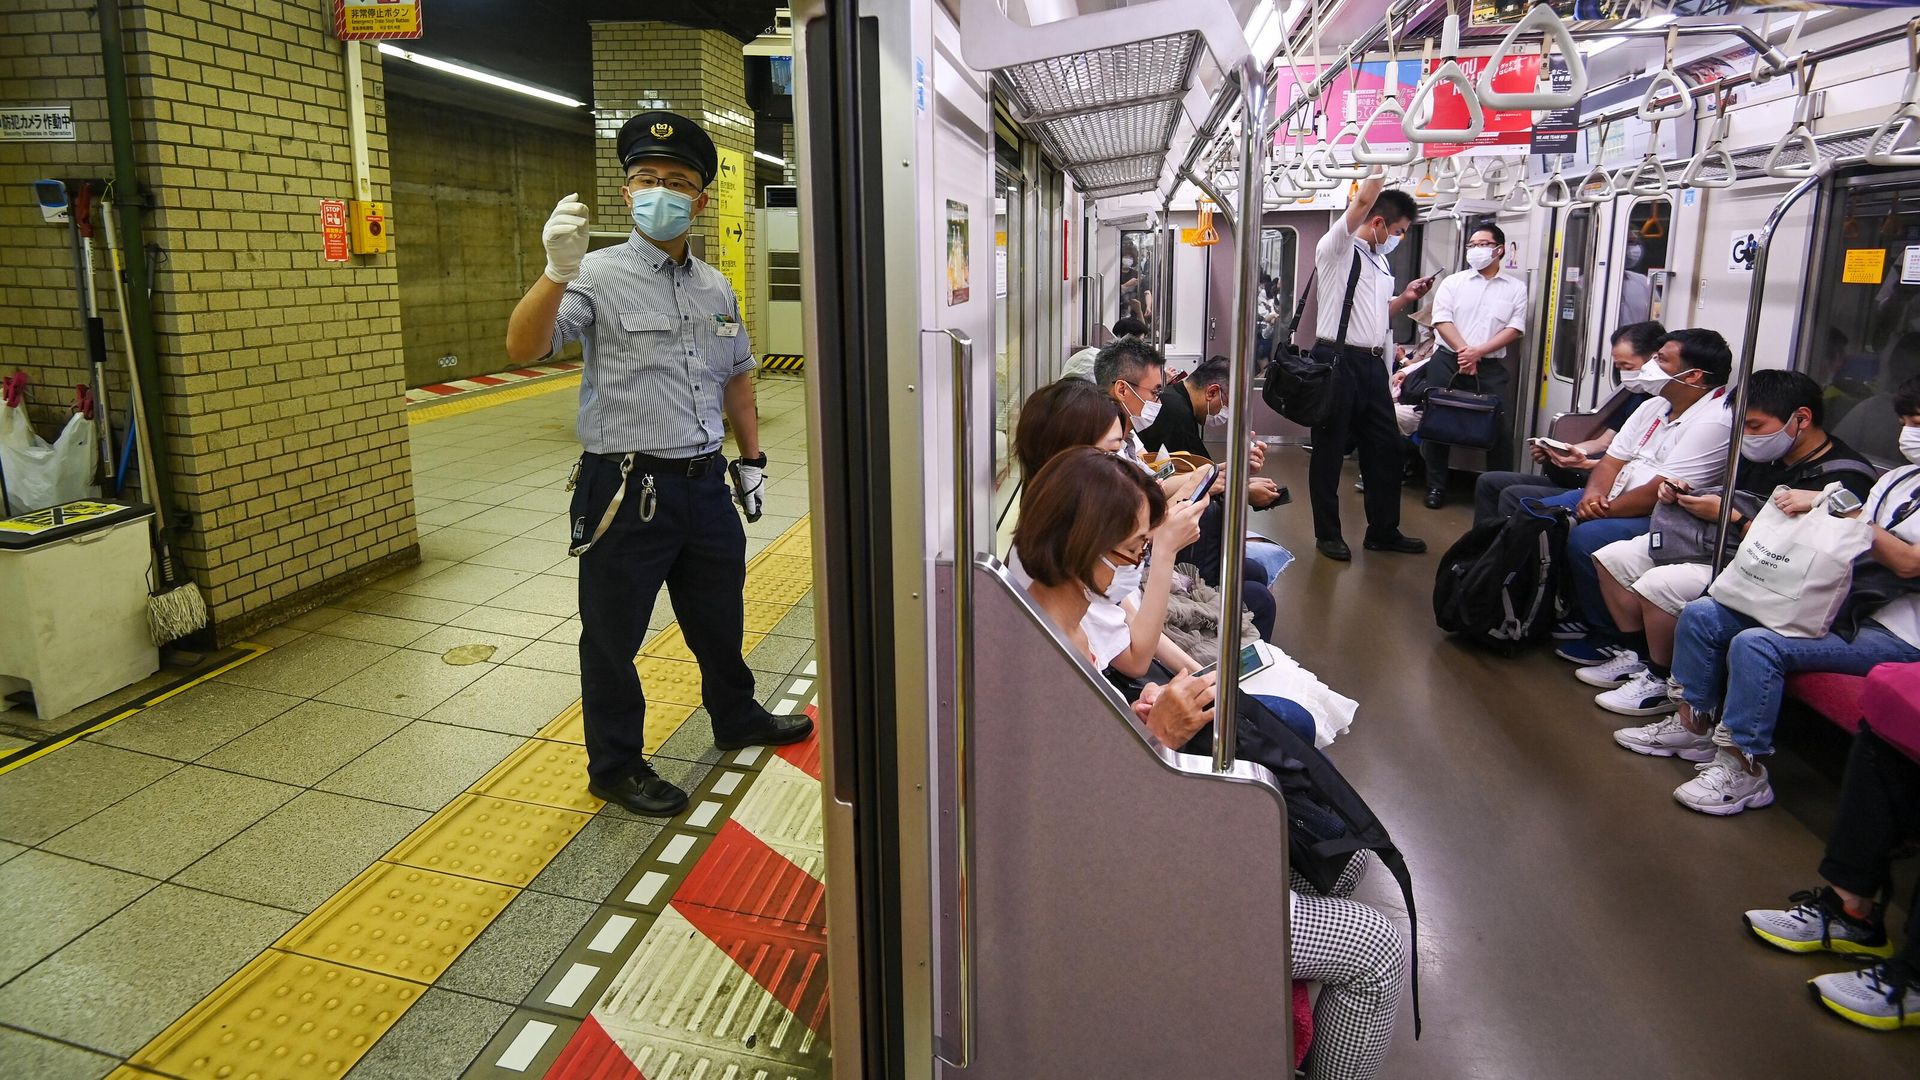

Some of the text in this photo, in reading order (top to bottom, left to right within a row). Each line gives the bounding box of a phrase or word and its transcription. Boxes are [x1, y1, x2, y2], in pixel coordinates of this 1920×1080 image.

[351, 8, 409, 19] 非常停止ボタン
